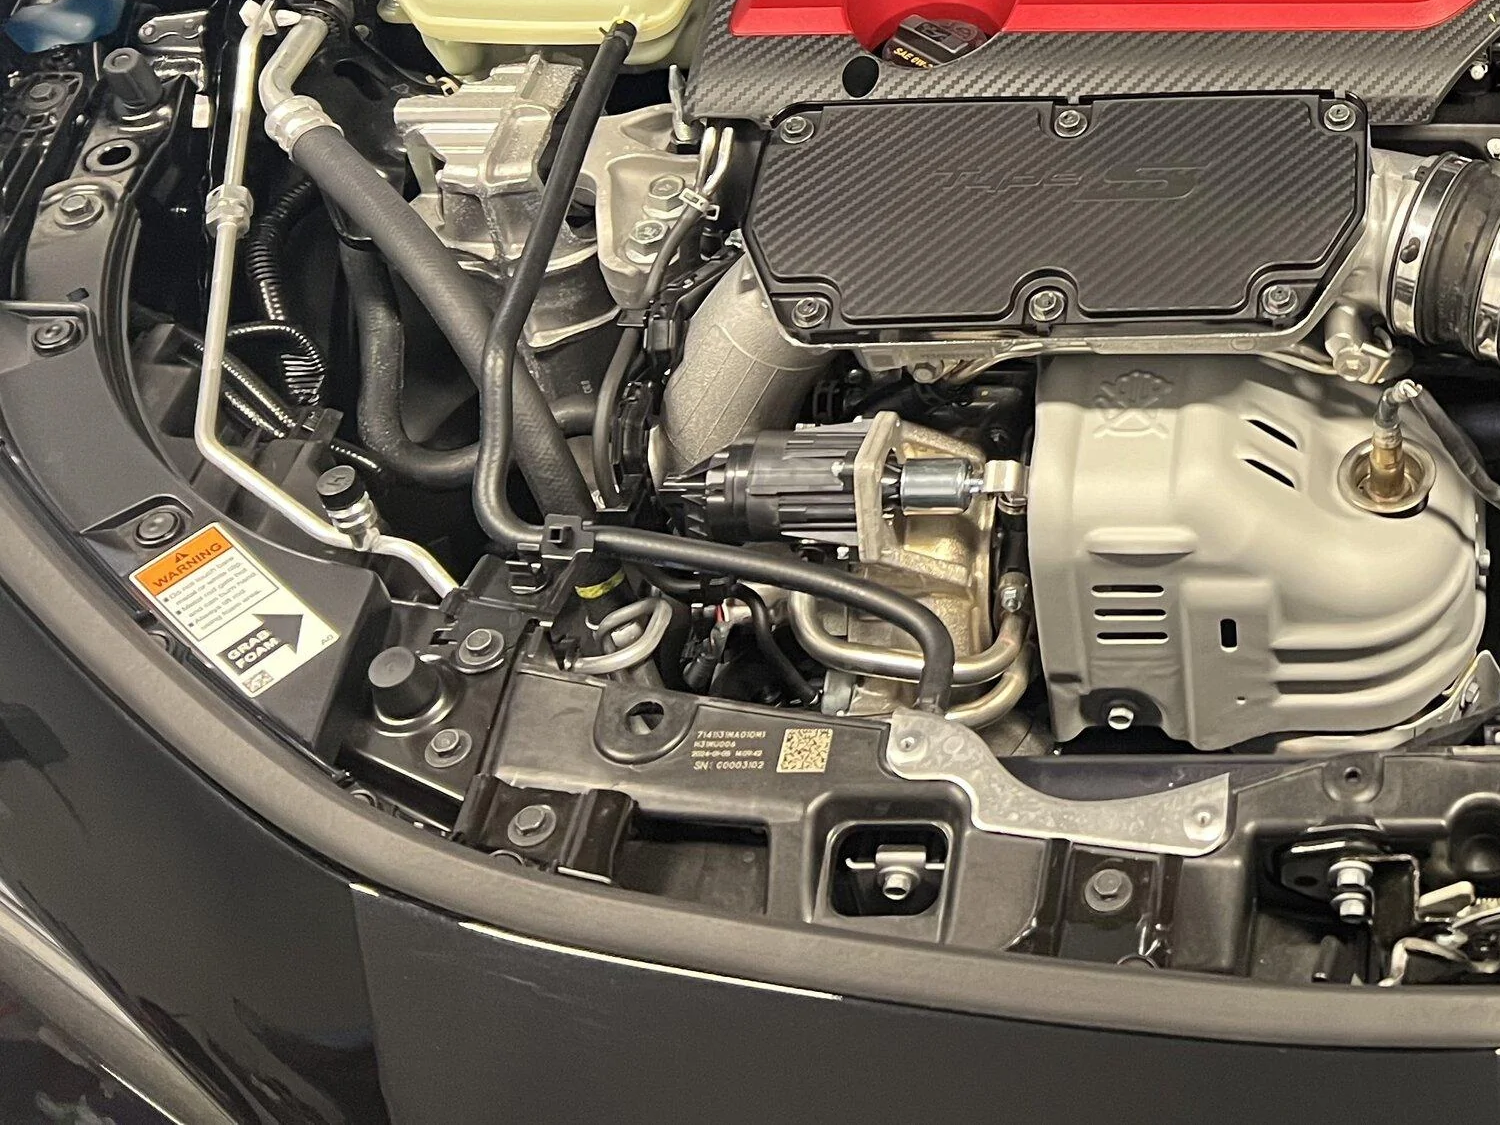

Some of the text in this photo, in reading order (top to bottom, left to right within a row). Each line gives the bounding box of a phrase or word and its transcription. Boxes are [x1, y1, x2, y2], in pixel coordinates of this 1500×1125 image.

[893, 47, 914, 60] SAE
[1072, 164, 1212, 203] S
[153, 542, 222, 588] WARNING
[227, 629, 273, 660] GRAB
[235, 636, 281, 670] FOAM
